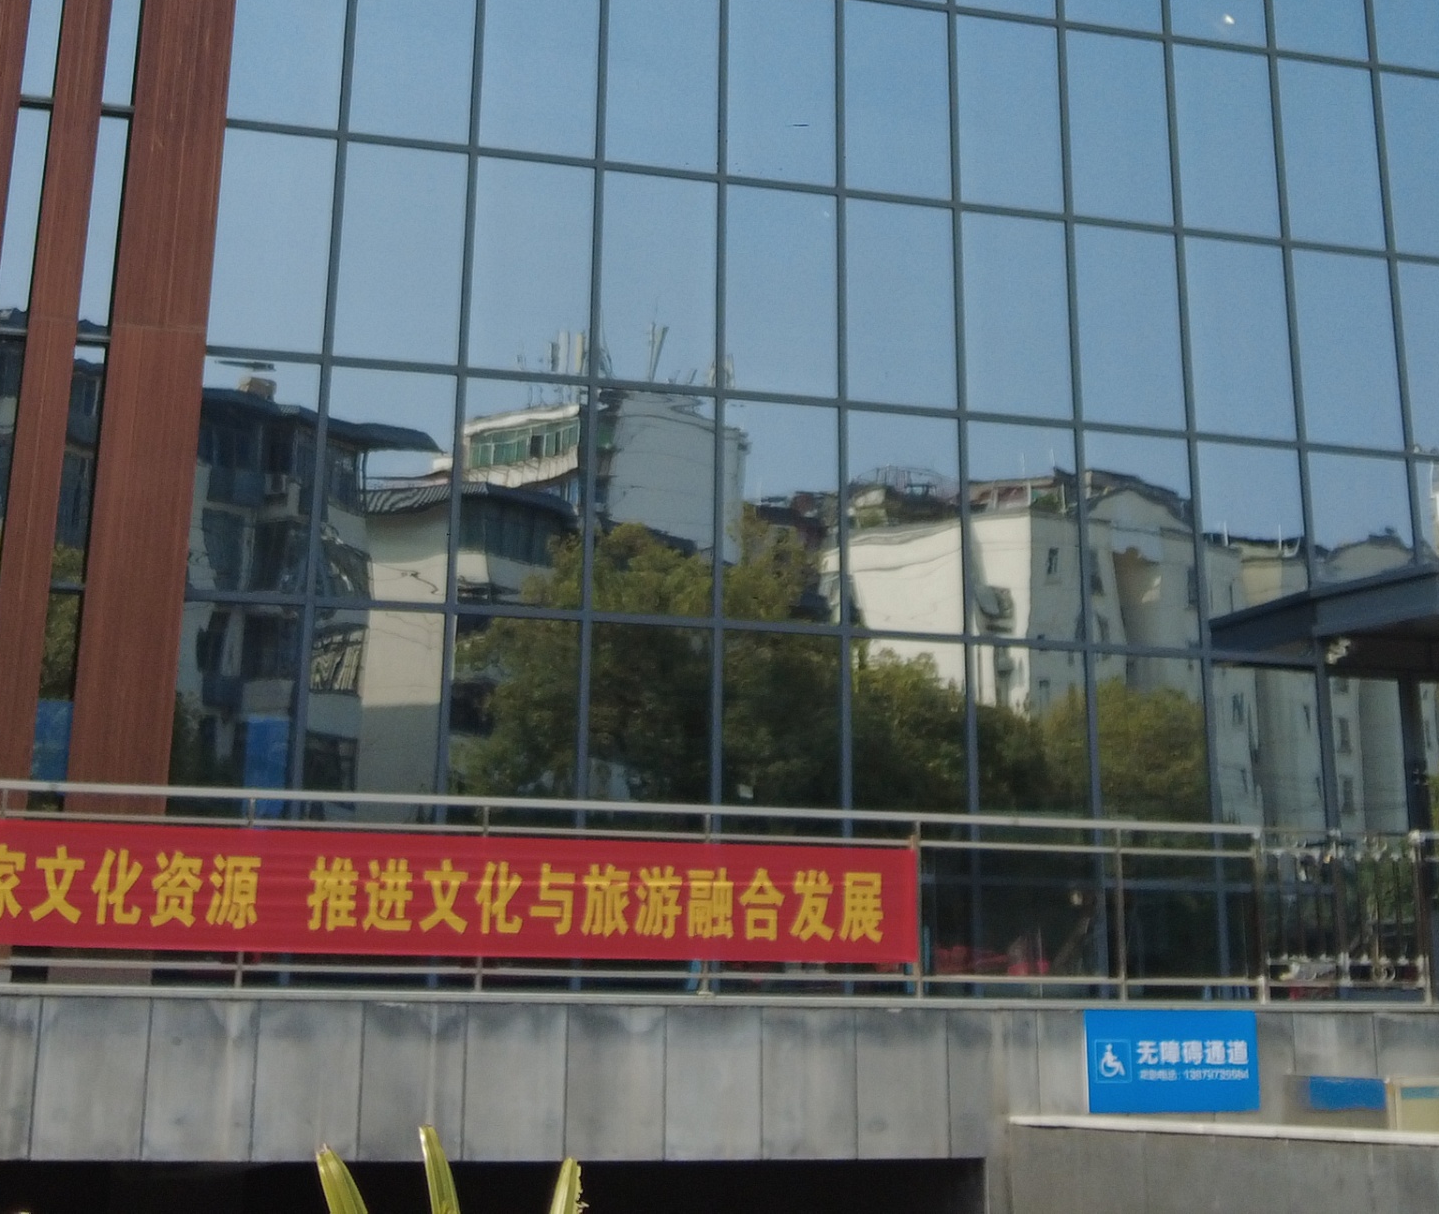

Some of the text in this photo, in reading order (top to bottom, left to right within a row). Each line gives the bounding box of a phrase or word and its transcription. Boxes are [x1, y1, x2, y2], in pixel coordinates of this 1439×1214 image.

[306, 855, 885, 943] 推进文化与旅游融合发展
[1137, 1040, 1248, 1065] 无障碍通道
